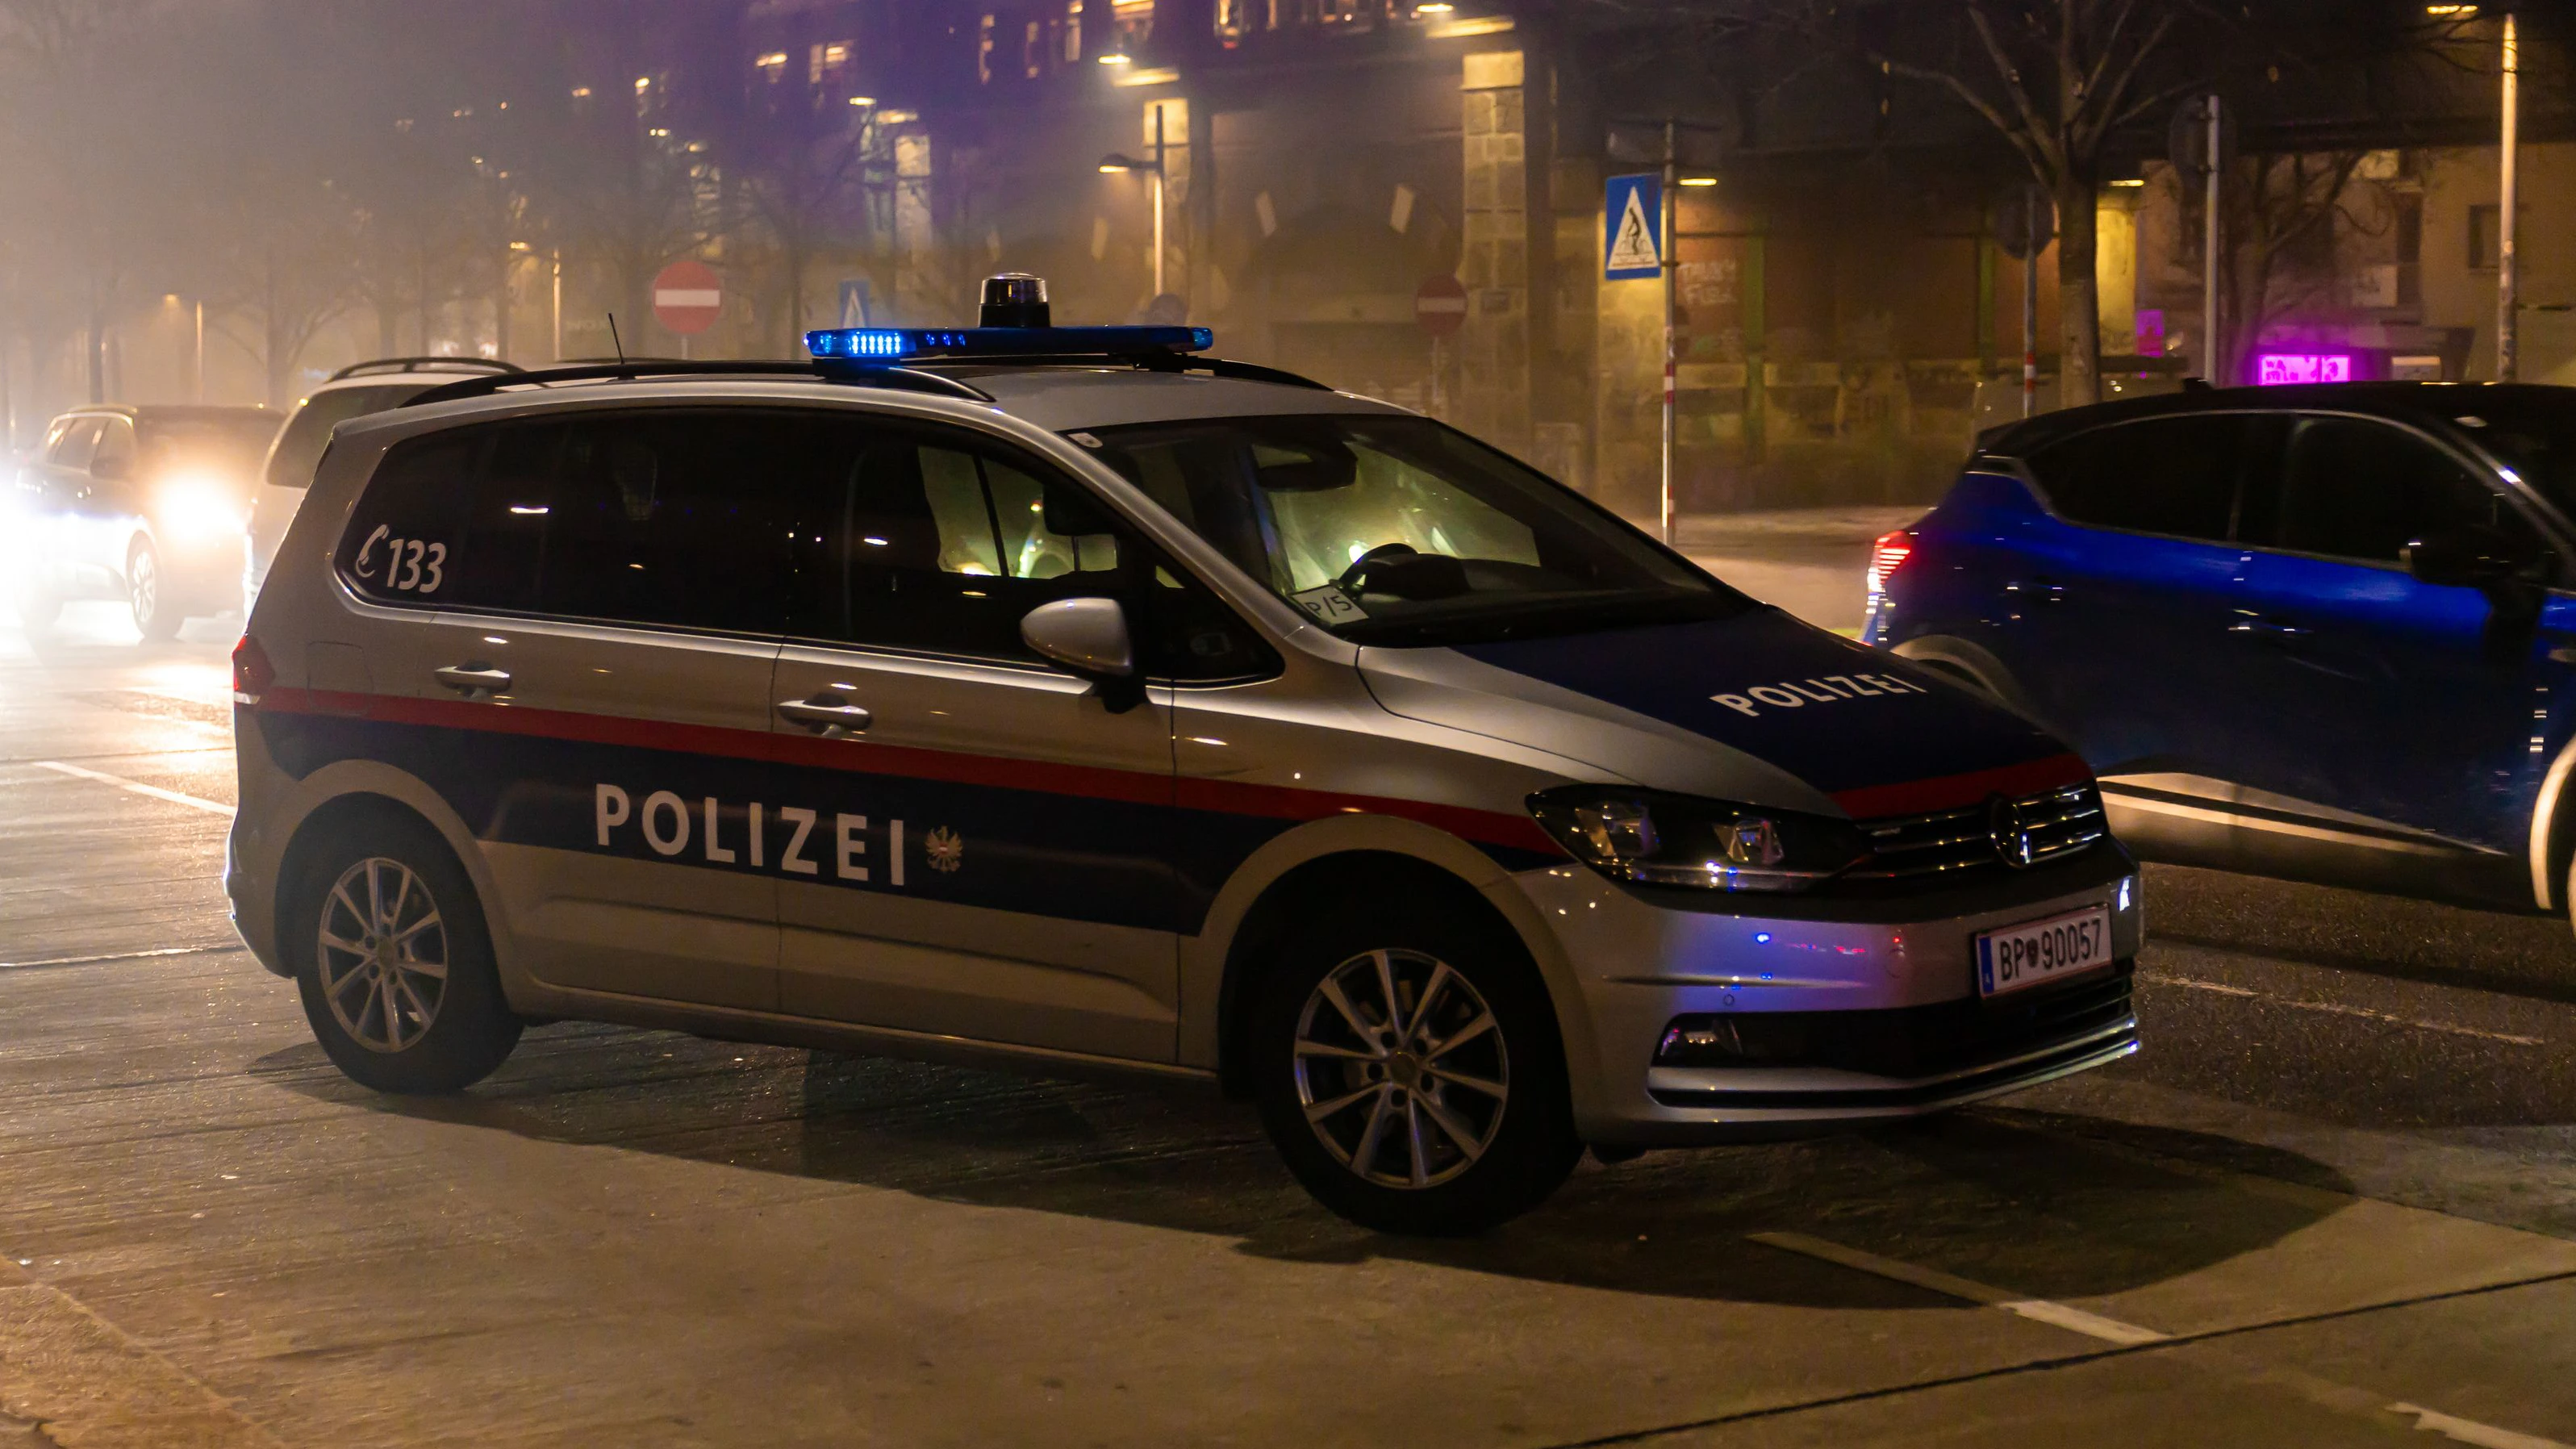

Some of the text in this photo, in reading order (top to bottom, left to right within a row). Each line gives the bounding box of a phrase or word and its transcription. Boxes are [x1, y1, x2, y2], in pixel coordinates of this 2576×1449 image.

[386, 538, 447, 593] 133
[1709, 674, 1930, 717] POLIZEI
[595, 783, 905, 886] POLIZEI
[2000, 917, 2101, 980] BP 90057
